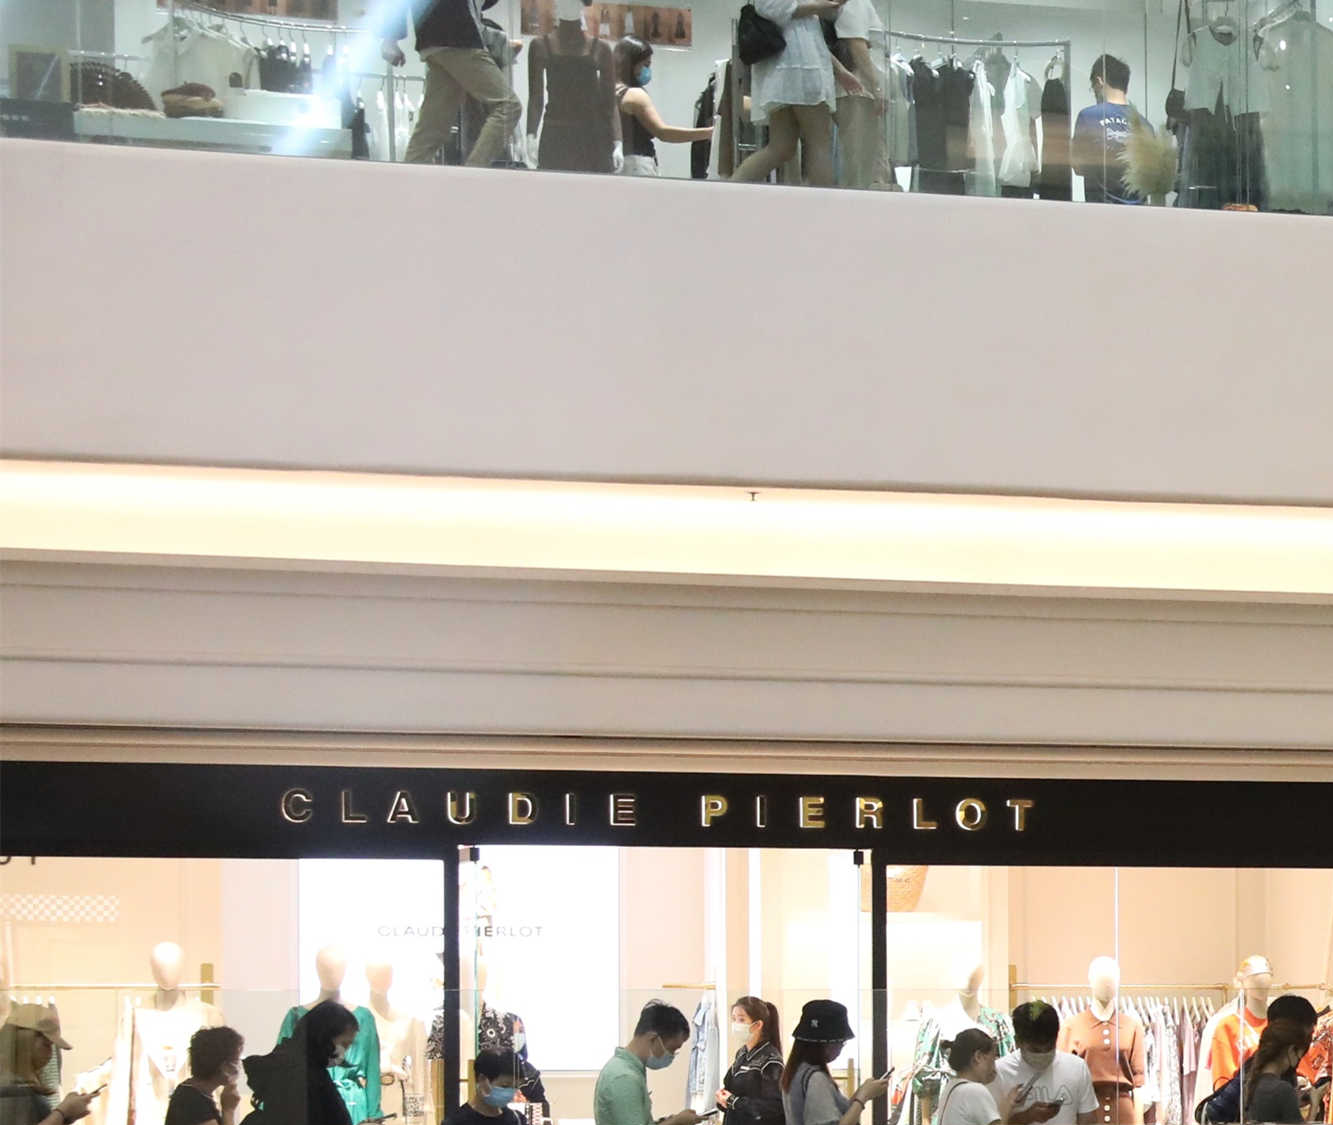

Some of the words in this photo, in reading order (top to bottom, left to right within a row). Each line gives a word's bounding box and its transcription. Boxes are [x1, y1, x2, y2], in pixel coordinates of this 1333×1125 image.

[281, 788, 637, 827] CLAUDIE
[700, 794, 1036, 832] PIERLOT
[465, 926, 544, 937] IERLOT
